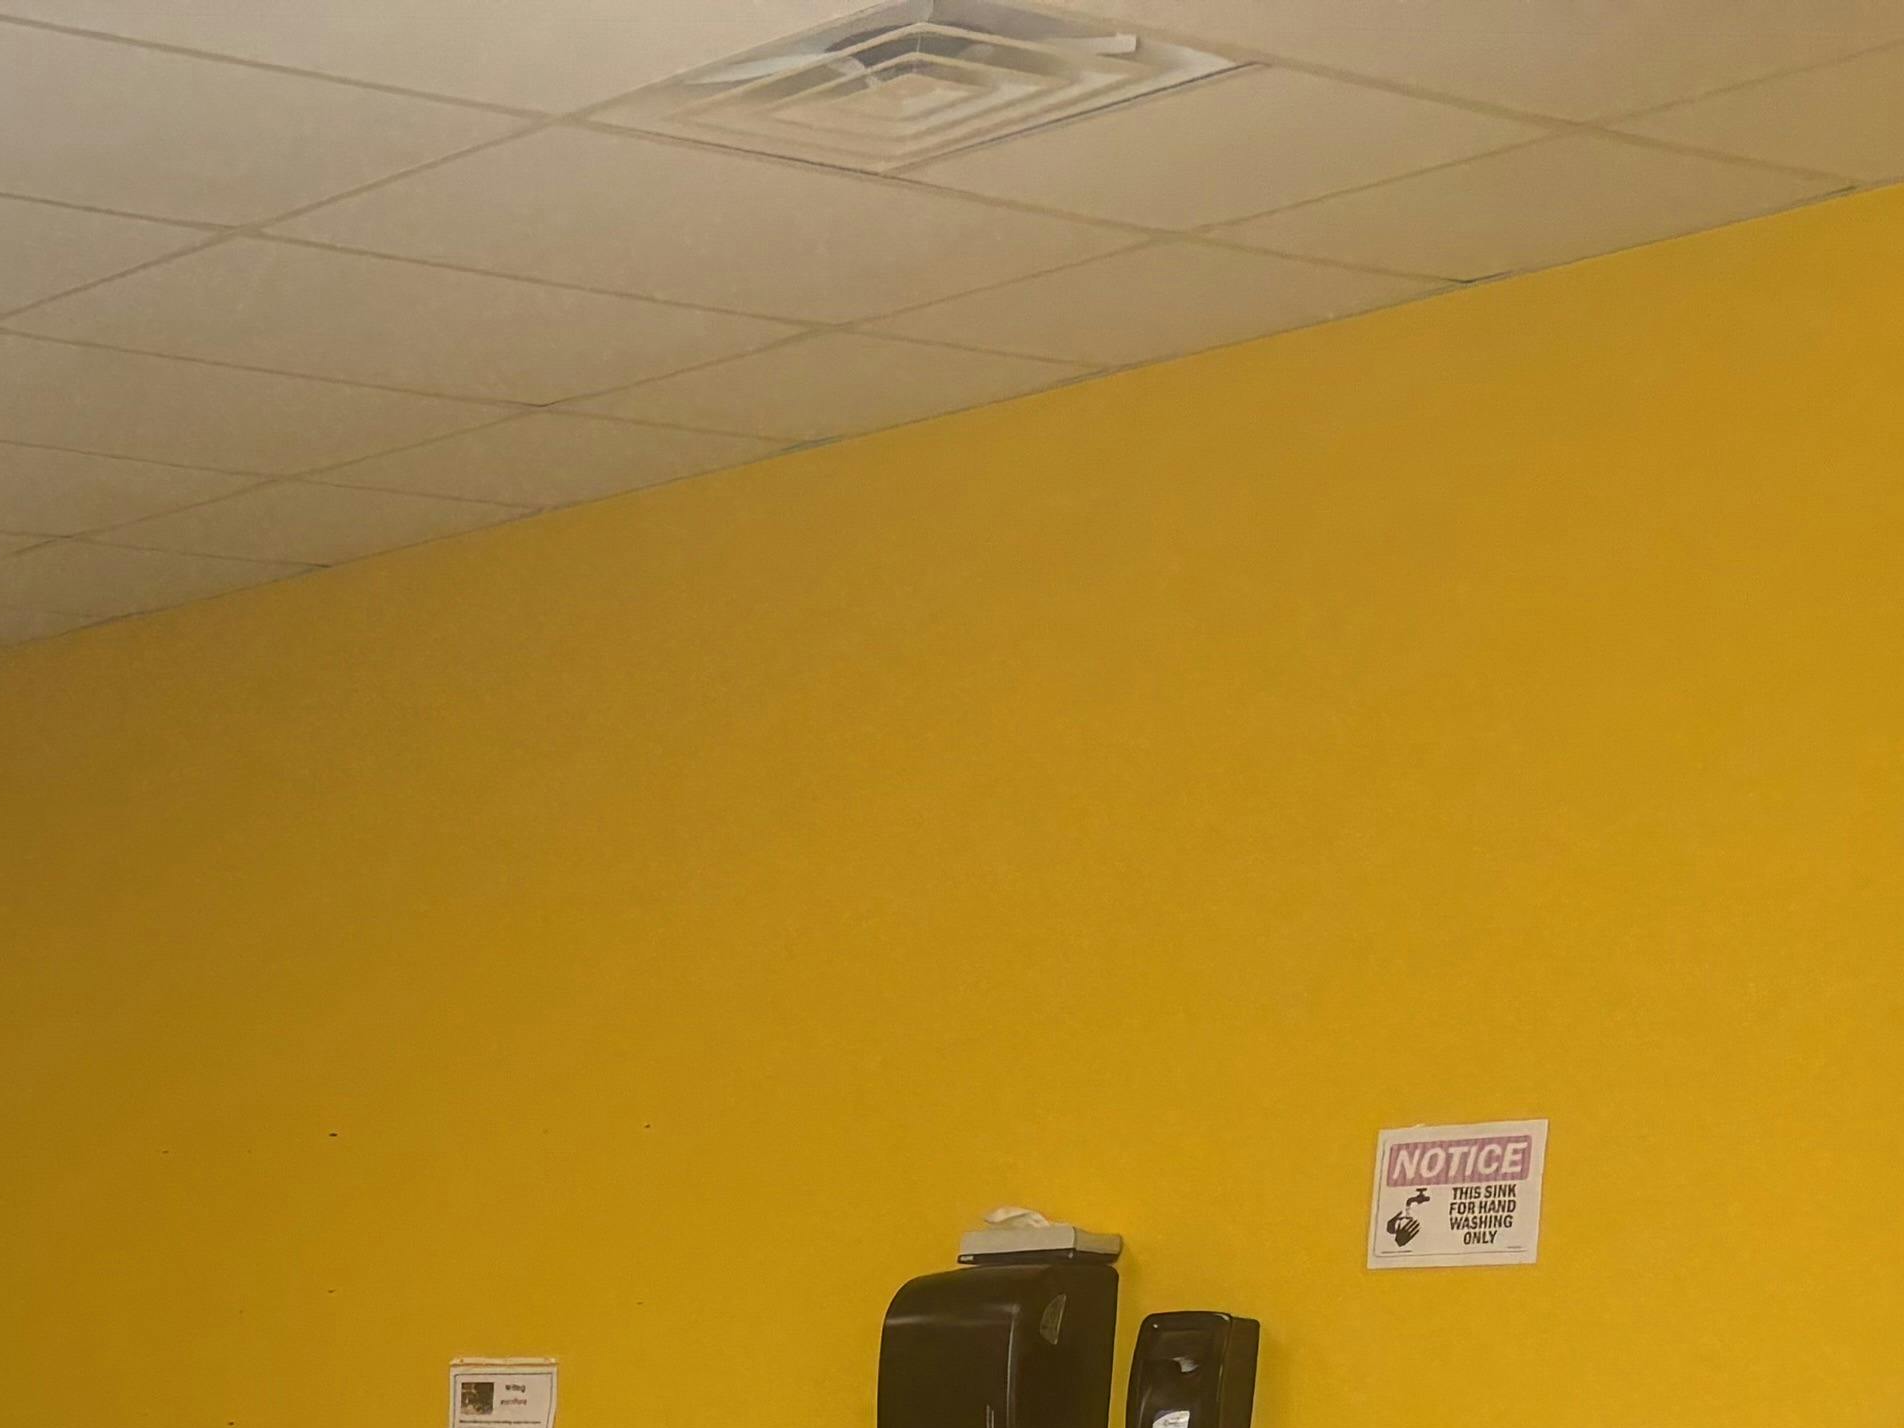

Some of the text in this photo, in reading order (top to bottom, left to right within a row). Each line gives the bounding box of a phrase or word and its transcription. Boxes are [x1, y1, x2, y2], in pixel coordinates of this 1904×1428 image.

[1392, 1141, 1528, 1180] NOTICE
[1452, 1184, 1517, 1200] THIS SINK
[1448, 1200, 1517, 1215] FOR HAND
[1449, 1215, 1513, 1230] WASHING
[1463, 1230, 1498, 1245] ONLY
